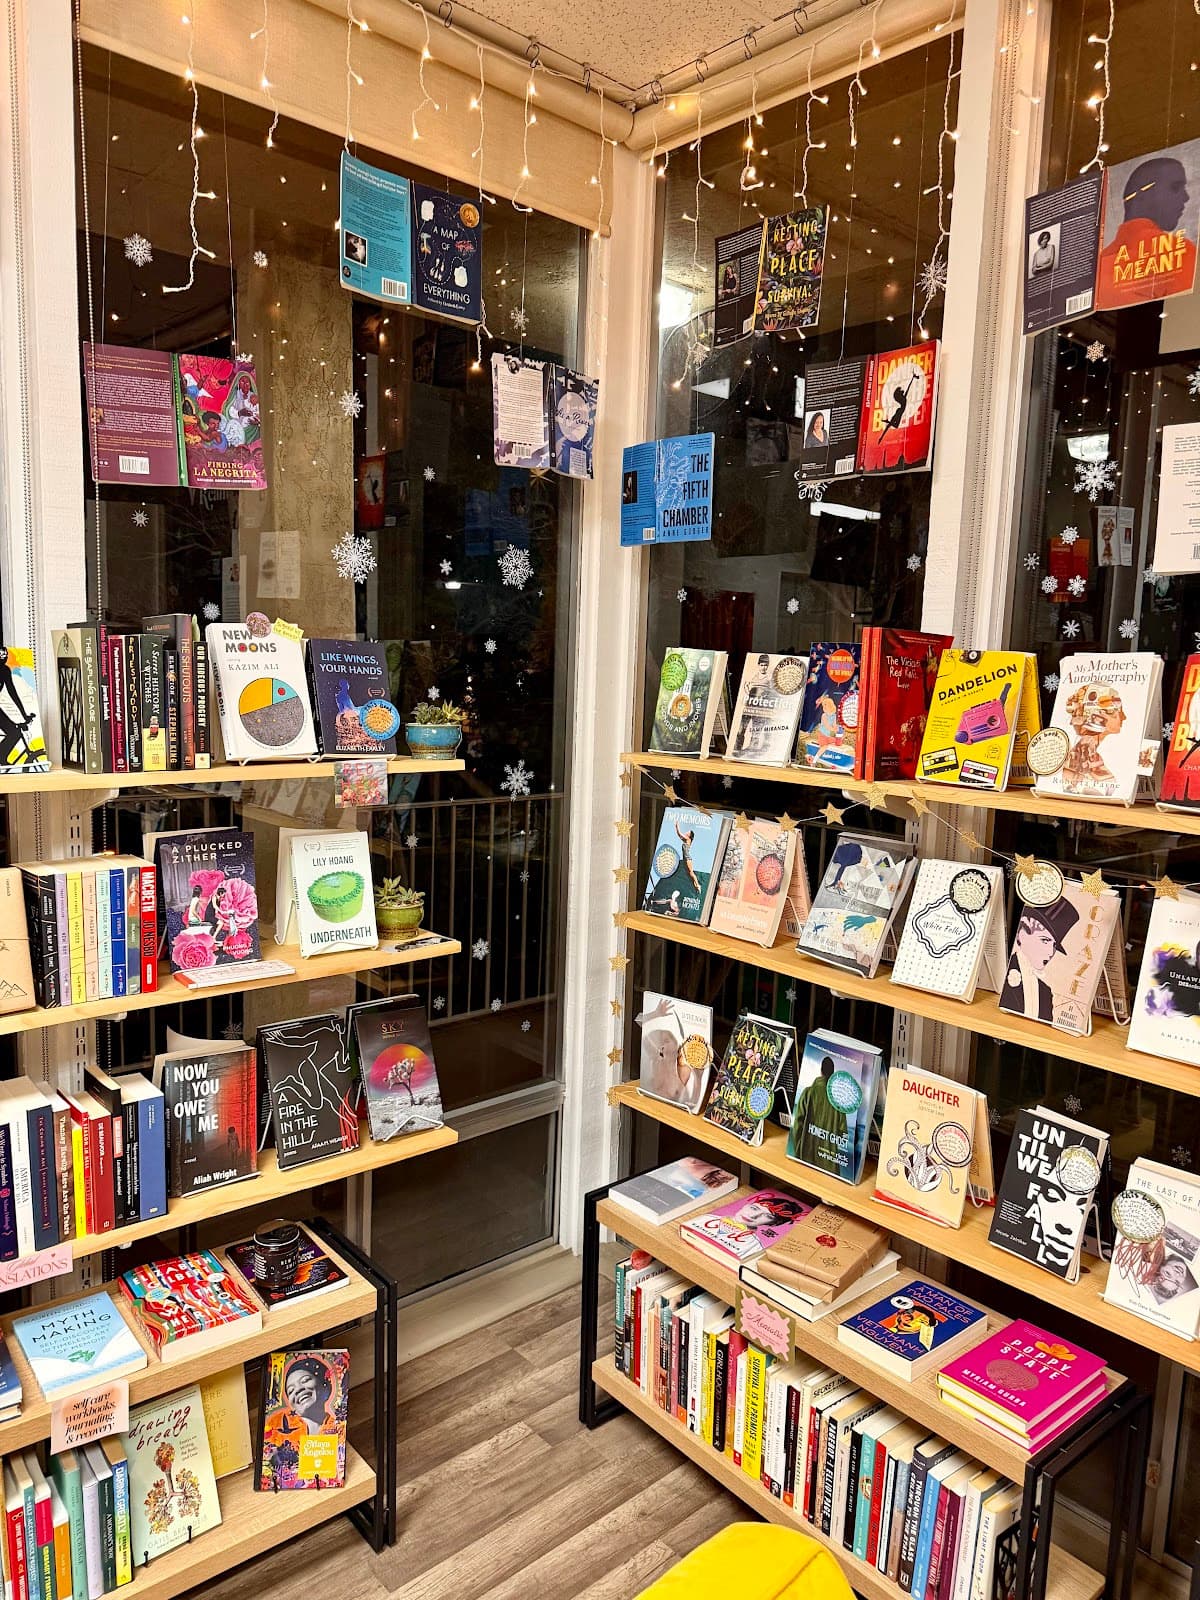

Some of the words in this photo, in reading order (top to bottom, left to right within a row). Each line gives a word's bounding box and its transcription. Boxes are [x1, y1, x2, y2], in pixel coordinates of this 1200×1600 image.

[433, 226, 438, 234] A
[440, 227, 459, 240] MAP
[773, 219, 818, 243] RESTING
[441, 242, 451, 251] OF
[1114, 245, 1129, 265] A
[1138, 229, 1187, 259] LINE
[770, 249, 817, 277] PLACE
[1113, 249, 1187, 283] MEANT
[423, 283, 471, 304] EVERYTHING
[194, 467, 207, 476] LA
[210, 469, 258, 478] NEGRITA
[207, 461, 244, 469] FINDING
[691, 453, 710, 473] THE
[682, 480, 709, 500] FIFTH
[663, 506, 708, 527] CHAMBER
[222, 629, 253, 640] NEW
[181, 638, 190, 655] THE
[197, 646, 205, 659] OUR
[320, 664, 347, 674] YOUR
[349, 665, 383, 675] HANDS
[321, 653, 342, 662] LIKE
[344, 653, 379, 665] WINGS,
[886, 656, 899, 666] The
[1075, 664, 1088, 673] My
[1088, 659, 1138, 671] Mother's
[142, 665, 152, 703] WITCHES
[181, 655, 191, 703] SHUTOUTS
[197, 662, 206, 695] HIDEOUS
[890, 667, 903, 678] Red
[938, 664, 1018, 701] DANDELION
[1063, 672, 1147, 685] Autobiography
[152, 677, 160, 715] HISTORY
[197, 696, 206, 727] PROGENY
[169, 707, 177, 742] STEPHEN
[169, 744, 177, 764] KING
[342, 763, 374, 775] RED
[681, 811, 711, 826] MEMOIRS
[172, 843, 179, 854] A
[186, 841, 242, 852] PLUCKED
[172, 852, 217, 864] ZITHER
[312, 857, 327, 867] LILY
[328, 855, 354, 866] HOANG
[141, 871, 155, 912] MACBETH
[143, 920, 154, 931] JO
[310, 926, 372, 944] UNDERNEATH
[736, 1029, 776, 1058] RESTING
[174, 1063, 208, 1082] NOW
[728, 1055, 770, 1085] PLACE
[192, 1079, 219, 1097] YOU
[277, 1092, 289, 1104] A
[902, 1079, 960, 1107] DAUGHTER
[174, 1099, 206, 1118] OWE
[278, 1103, 305, 1119] FIRE
[198, 1114, 219, 1132] ME
[280, 1122, 293, 1134] IN
[294, 1115, 319, 1130] THE
[1032, 1120, 1066, 1148] UN
[808, 1124, 828, 1141] HONEST
[830, 1131, 849, 1149] GHOST
[1018, 1134, 1050, 1161] TIL
[835, 1152, 848, 1162] rick
[1017, 1152, 1053, 1179] WE
[20, 1167, 29, 1203] AMERICA
[193, 1174, 212, 1185] Aliah
[213, 1169, 237, 1183] Wright
[1136, 1178, 1151, 1189] THE
[1156, 1185, 1178, 1198] LAST
[1182, 1193, 1193, 1202] OF
[748, 1193, 810, 1222] Rebel
[720, 1237, 740, 1251] HANNA
[132, 1256, 212, 1285] ELIZABETH
[147, 1265, 209, 1288] GILBERT
[162, 1314, 190, 1330] THE
[194, 1297, 245, 1319] RIVER
[906, 1287, 934, 1303] TWO
[934, 1301, 972, 1324] FACES
[927, 1290, 953, 1307] MAN
[955, 1305, 974, 1316] OF
[32, 1313, 112, 1343] MAKING
[42, 1309, 94, 1331] MYTH
[71, 1336, 107, 1350] MEMOIR
[856, 1315, 882, 1329] VIET
[883, 1328, 926, 1354] THANH
[857, 1324, 907, 1353] NGUYEN
[1000, 1346, 1061, 1380] STATE
[1011, 1339, 1071, 1372] POPPY
[716, 1349, 724, 1400] GIRLHOOD
[753, 1357, 761, 1388] SURVIVAL
[813, 1381, 836, 1398] SECRET
[961, 1369, 996, 1390] MYRIAM
[997, 1389, 1027, 1407] GURBA
[73, 1398, 89, 1410] self
[91, 1392, 111, 1403] care
[75, 1421, 115, 1442] recovery
[129, 1405, 191, 1439] drawing
[750, 1408, 758, 1441] PROMISE
[137, 1418, 189, 1451] breath
[116, 1467, 124, 1497] DARING
[826, 1465, 835, 1496] ELLIOT
[908, 1472, 917, 1501] CEILING
[824, 1496, 833, 1519] PAGE
[906, 1504, 912, 1517] TO
[912, 1480, 923, 1518] THROUGH
[117, 1498, 126, 1533] GREATLY
[907, 1533, 917, 1562] GLASS
